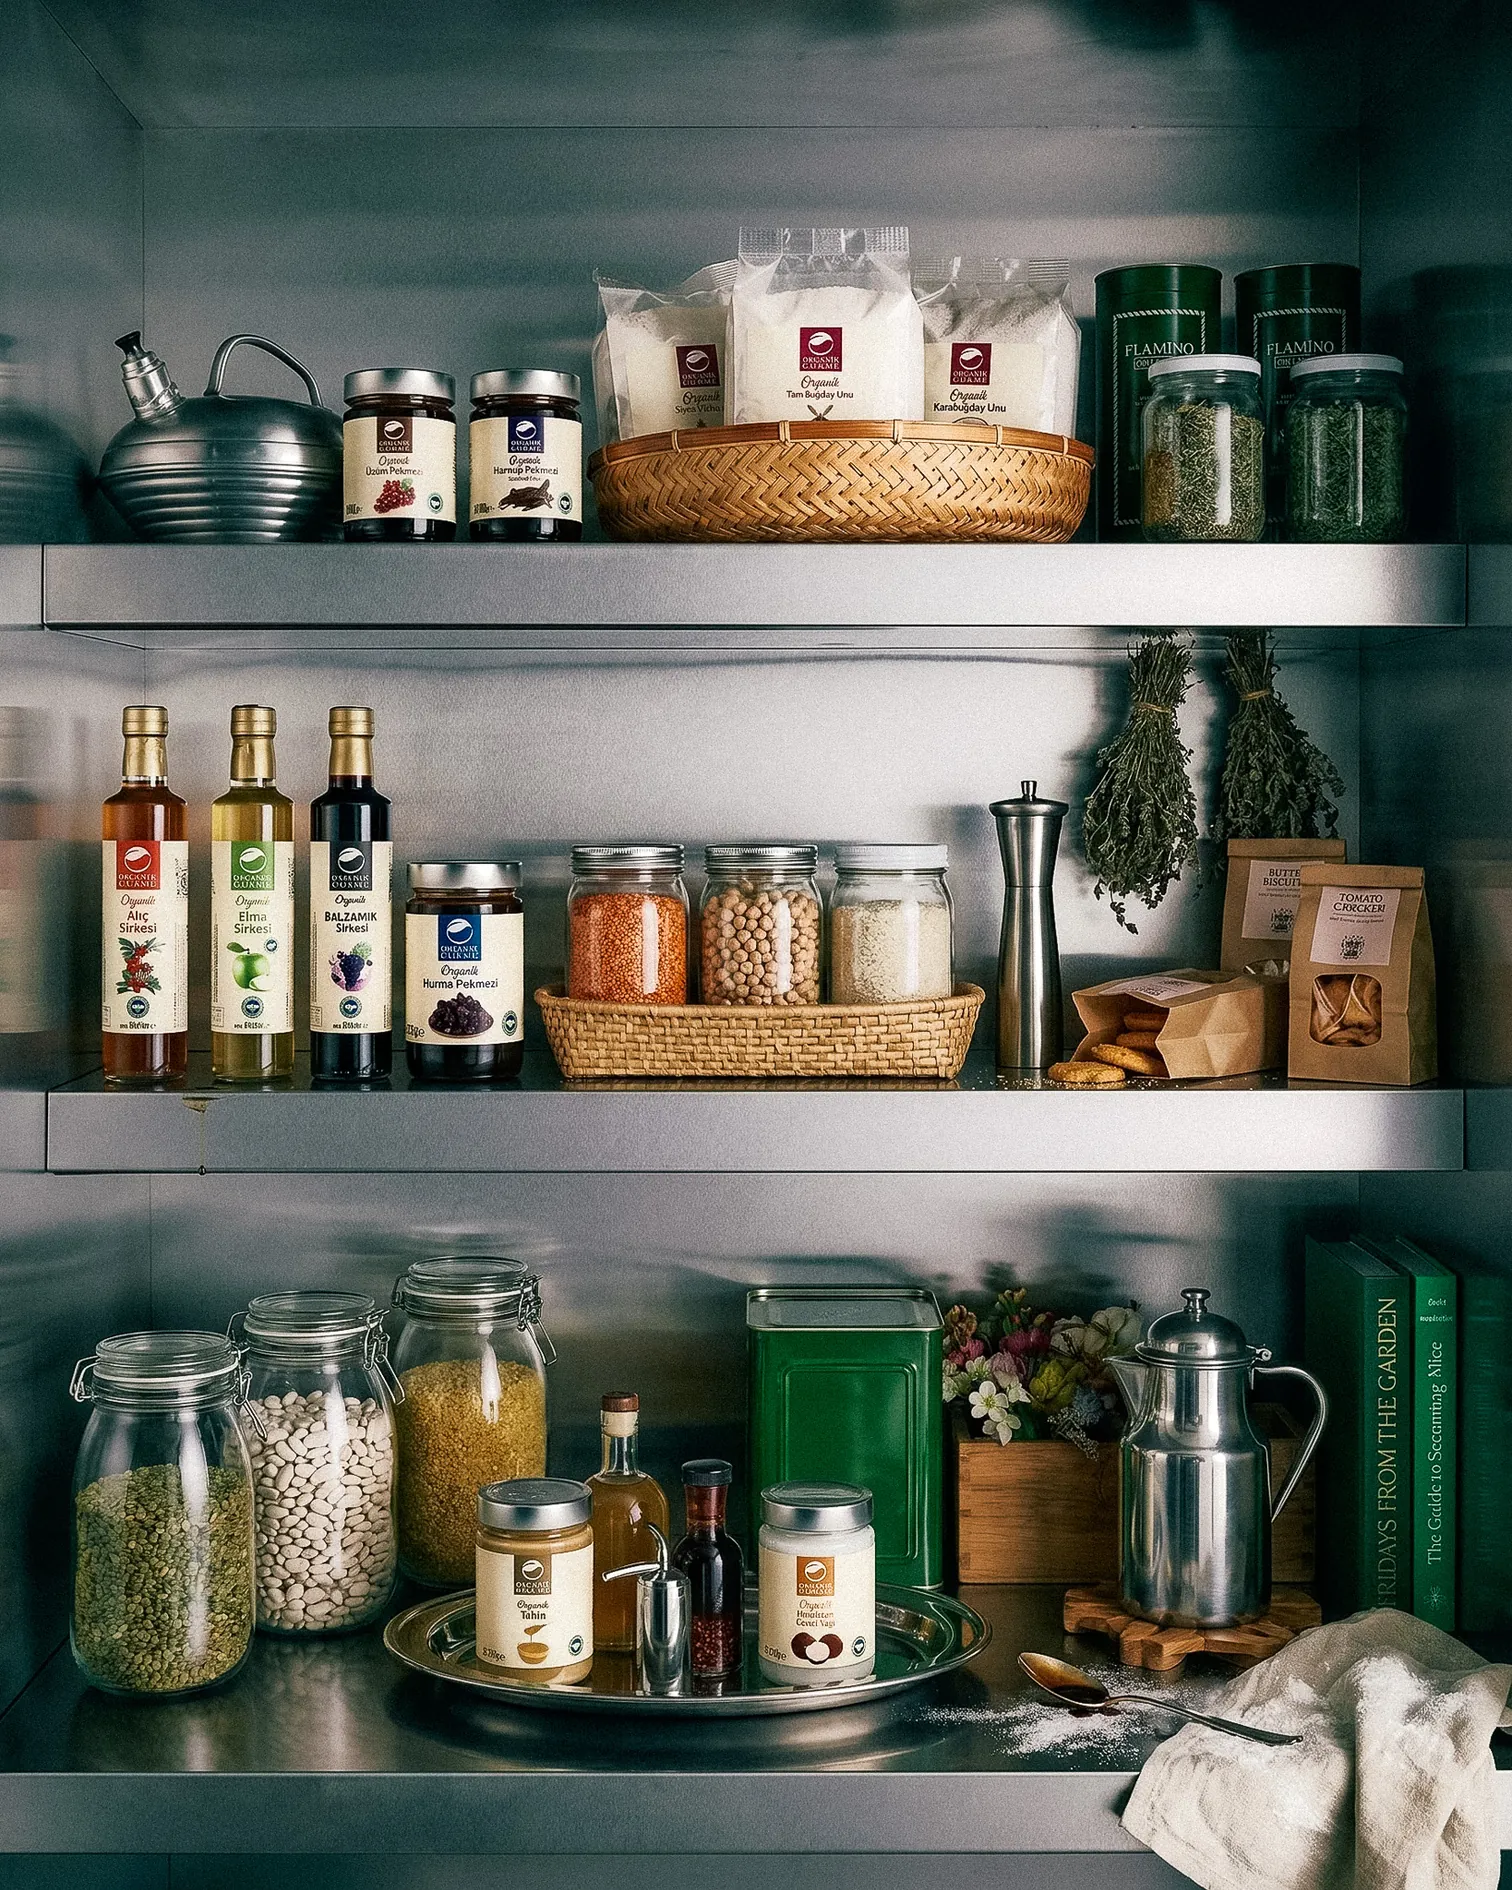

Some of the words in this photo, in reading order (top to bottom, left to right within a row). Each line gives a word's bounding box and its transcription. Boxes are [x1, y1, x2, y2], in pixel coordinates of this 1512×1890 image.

[1125, 341, 1195, 357] FLAMINO
[1267, 340, 1335, 356] FLAMINO
[786, 390, 804, 399] Tam
[836, 391, 854, 399] Unu
[987, 403, 1007, 412] Unu
[493, 466, 524, 476] Harnup
[1269, 868, 1301, 877] BUTTE
[1339, 893, 1384, 903] TOMATO
[127, 910, 149, 924] Alıç
[239, 911, 267, 922] Elma
[324, 911, 377, 922] BALZAMIK
[119, 922, 157, 933] Sirkesi
[234, 923, 272, 934] Sirkesi
[423, 979, 453, 989] Hurma
[456, 979, 498, 989] Pekmezi
[1377, 1298, 1397, 1392] GARDEN
[1377, 1396, 1397, 1444] THE
[1377, 1448, 1397, 1511] FROM
[520, 1610, 547, 1620] Tahin
